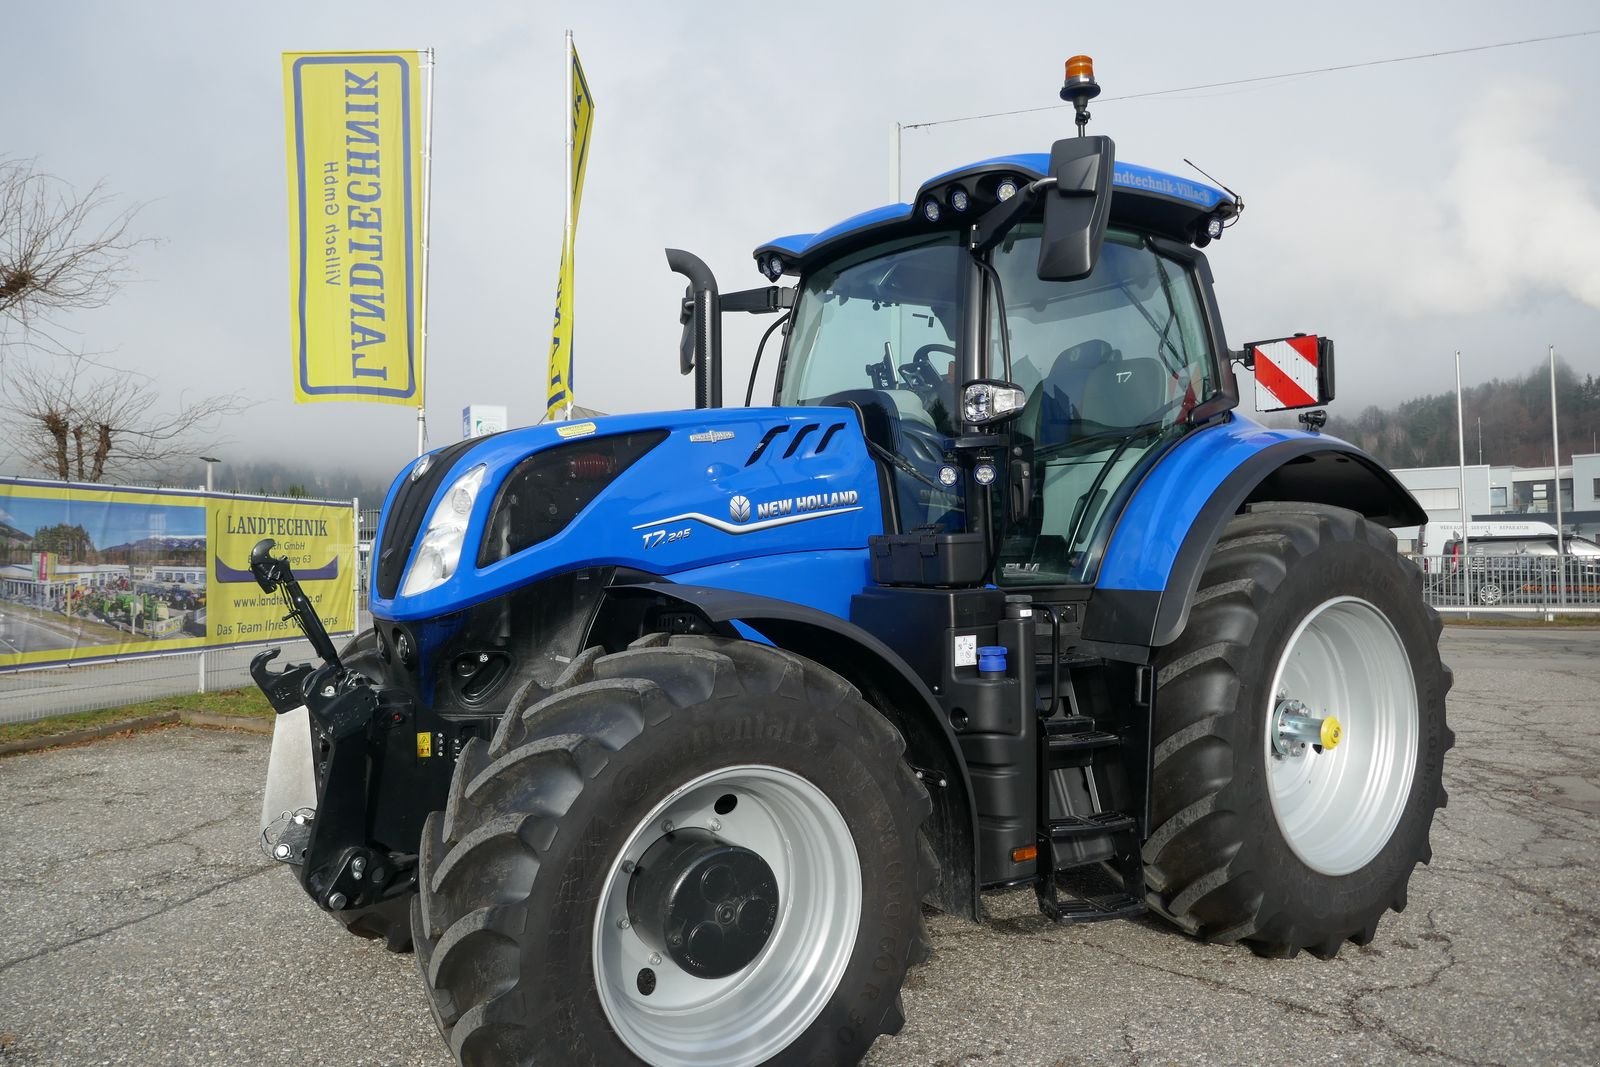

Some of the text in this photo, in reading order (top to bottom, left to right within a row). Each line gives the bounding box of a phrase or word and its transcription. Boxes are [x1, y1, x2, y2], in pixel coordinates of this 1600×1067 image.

[1113, 171, 1211, 204] ndtechnik-Villach
[757, 490, 858, 520] NEW HOLLAND
[227, 515, 328, 536] LANDTECHNIK
[284, 541, 305, 550] GmbH
[642, 528, 691, 549] T7.245
[302, 554, 312, 563] 63
[217, 624, 232, 635] Das
[237, 622, 262, 634] Team
[265, 620, 288, 631] Ihres
